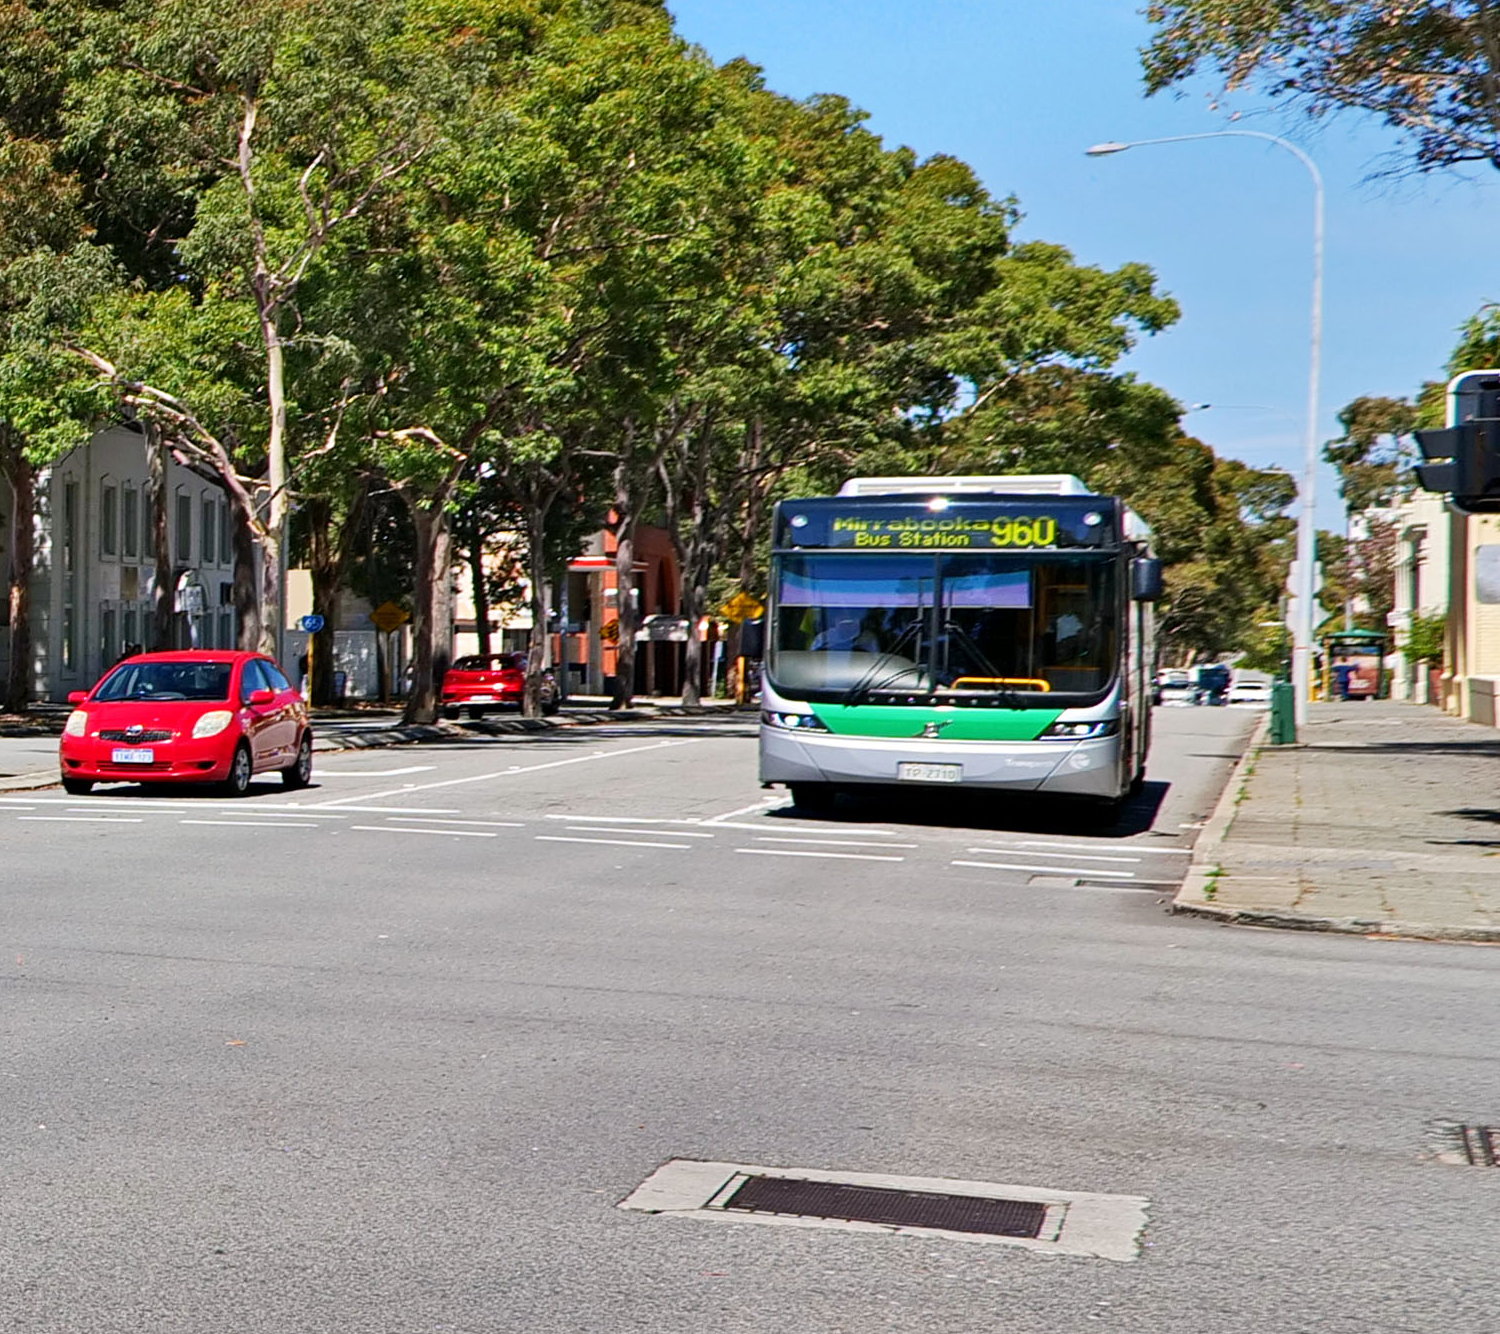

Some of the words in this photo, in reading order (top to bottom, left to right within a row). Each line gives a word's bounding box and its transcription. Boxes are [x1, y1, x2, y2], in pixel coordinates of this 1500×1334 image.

[833, 517, 990, 531] Mirrabooka
[991, 516, 1057, 546] 960
[854, 532, 891, 546] Bus
[899, 531, 970, 546] Station
